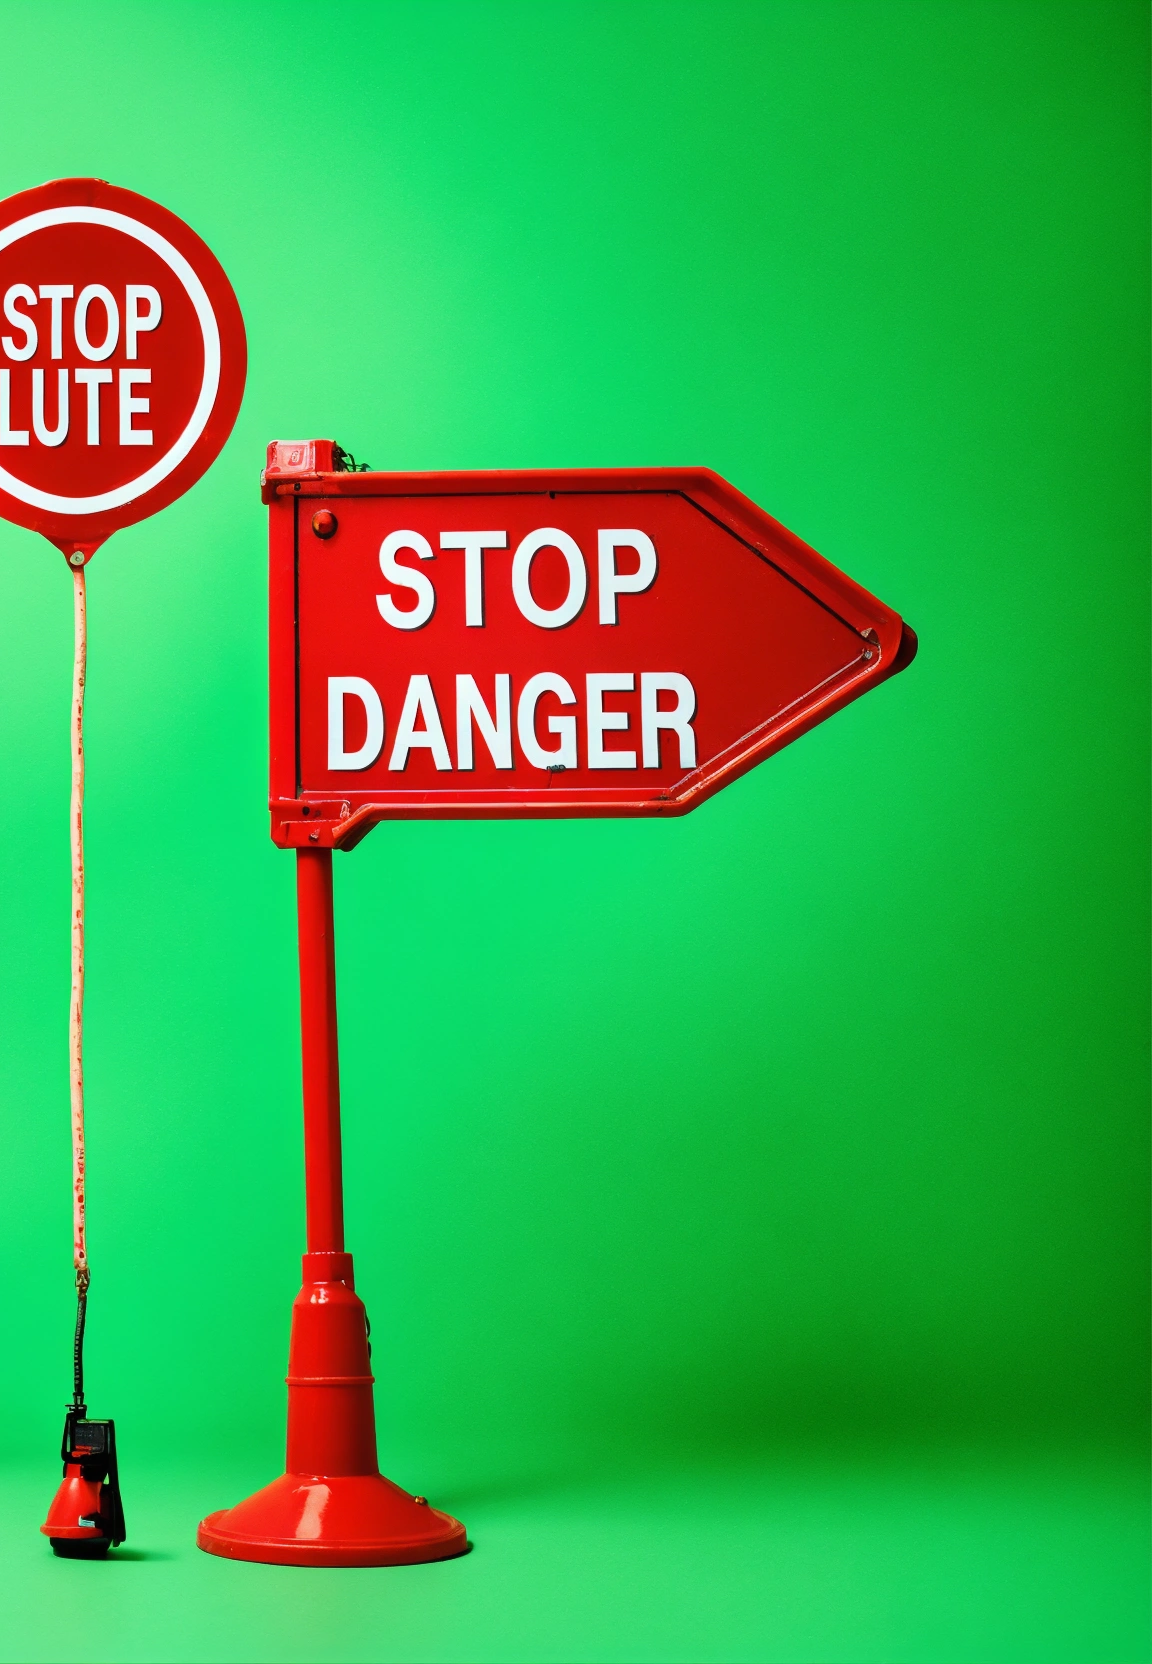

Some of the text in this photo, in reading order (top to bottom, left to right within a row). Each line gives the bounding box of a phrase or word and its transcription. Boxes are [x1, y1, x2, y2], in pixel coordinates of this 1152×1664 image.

[1, 283, 163, 362] STOP
[375, 527, 657, 630] STOP
[327, 671, 697, 771] DANGER
